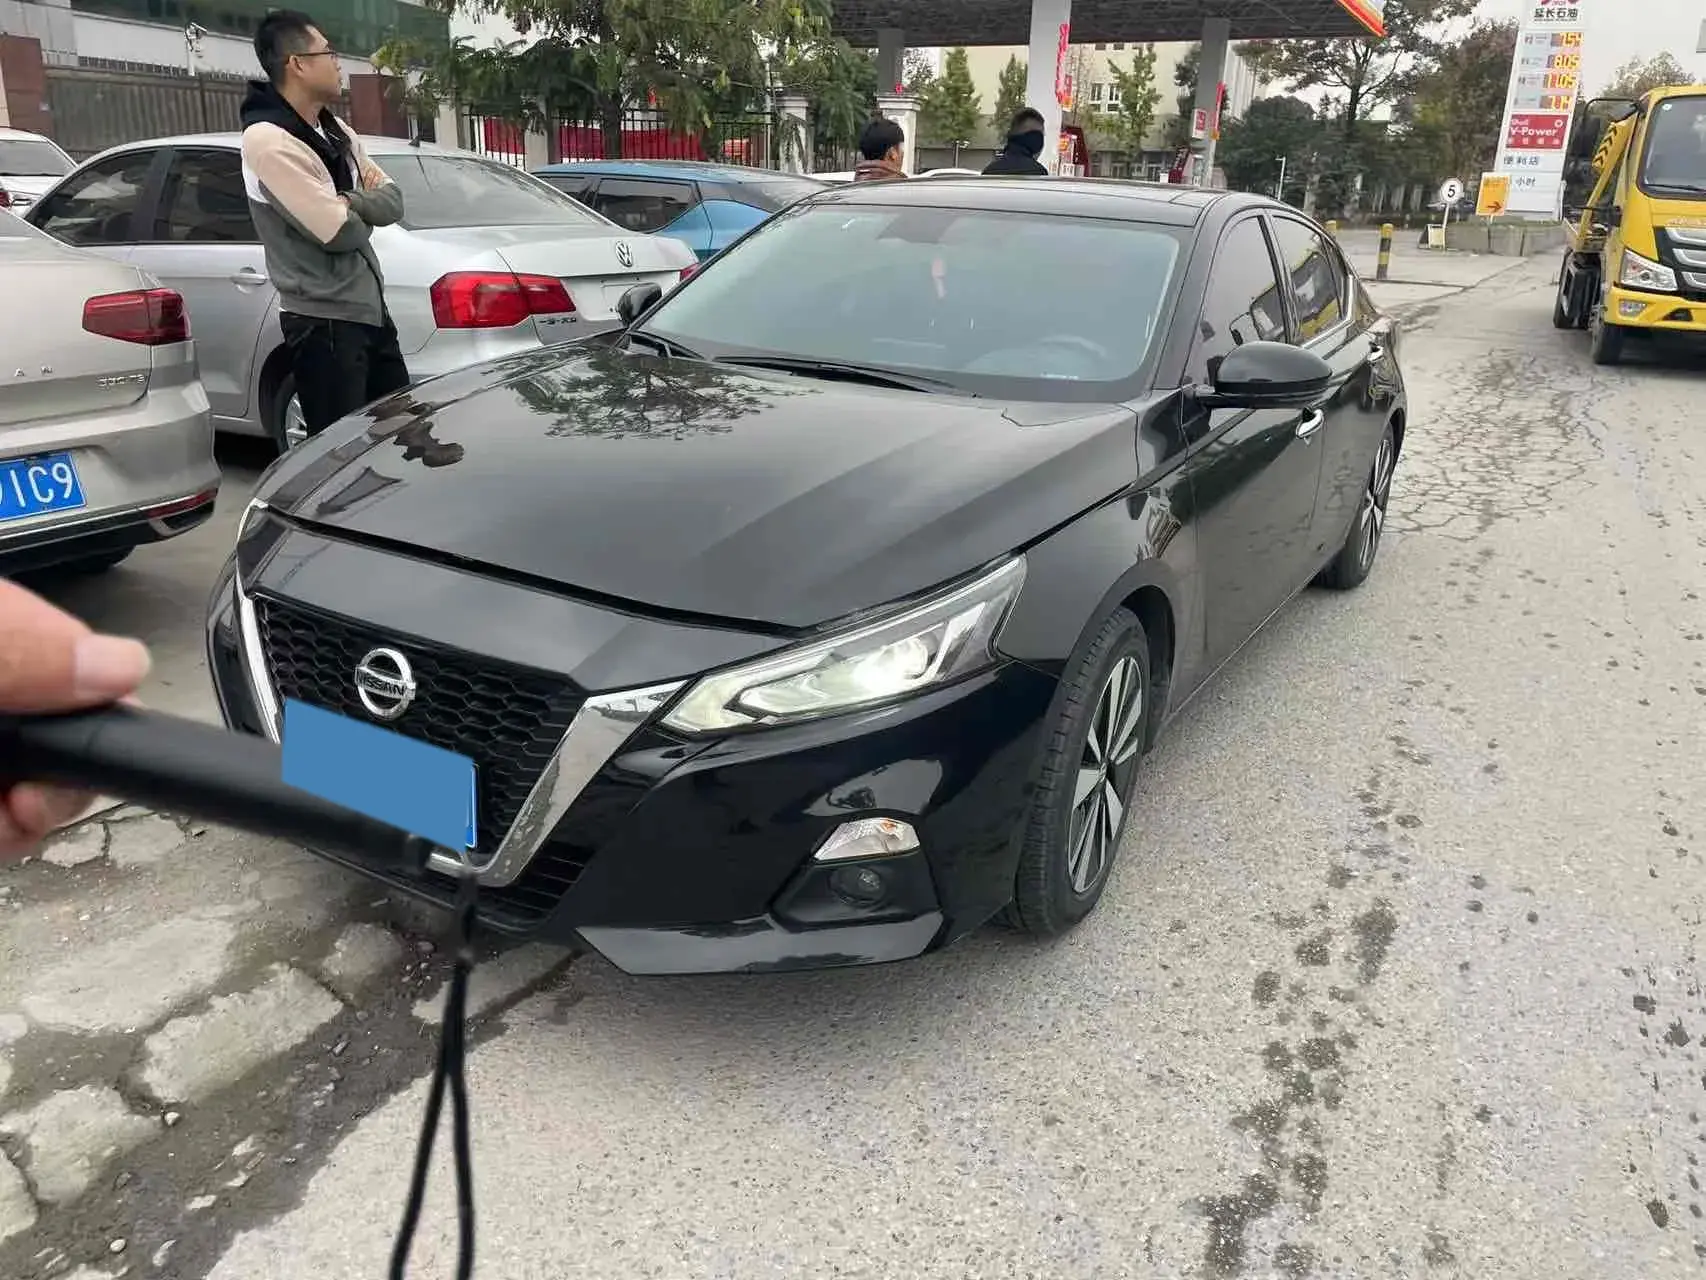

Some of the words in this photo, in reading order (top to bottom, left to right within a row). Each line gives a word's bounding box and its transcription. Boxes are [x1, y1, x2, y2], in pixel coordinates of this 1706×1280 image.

[1533, 7, 1578, 18] 延长石油
[1510, 126, 1558, 136] V-Power
[1447, 184, 1456, 198] 5
[0, 462, 73, 508] 1C9
